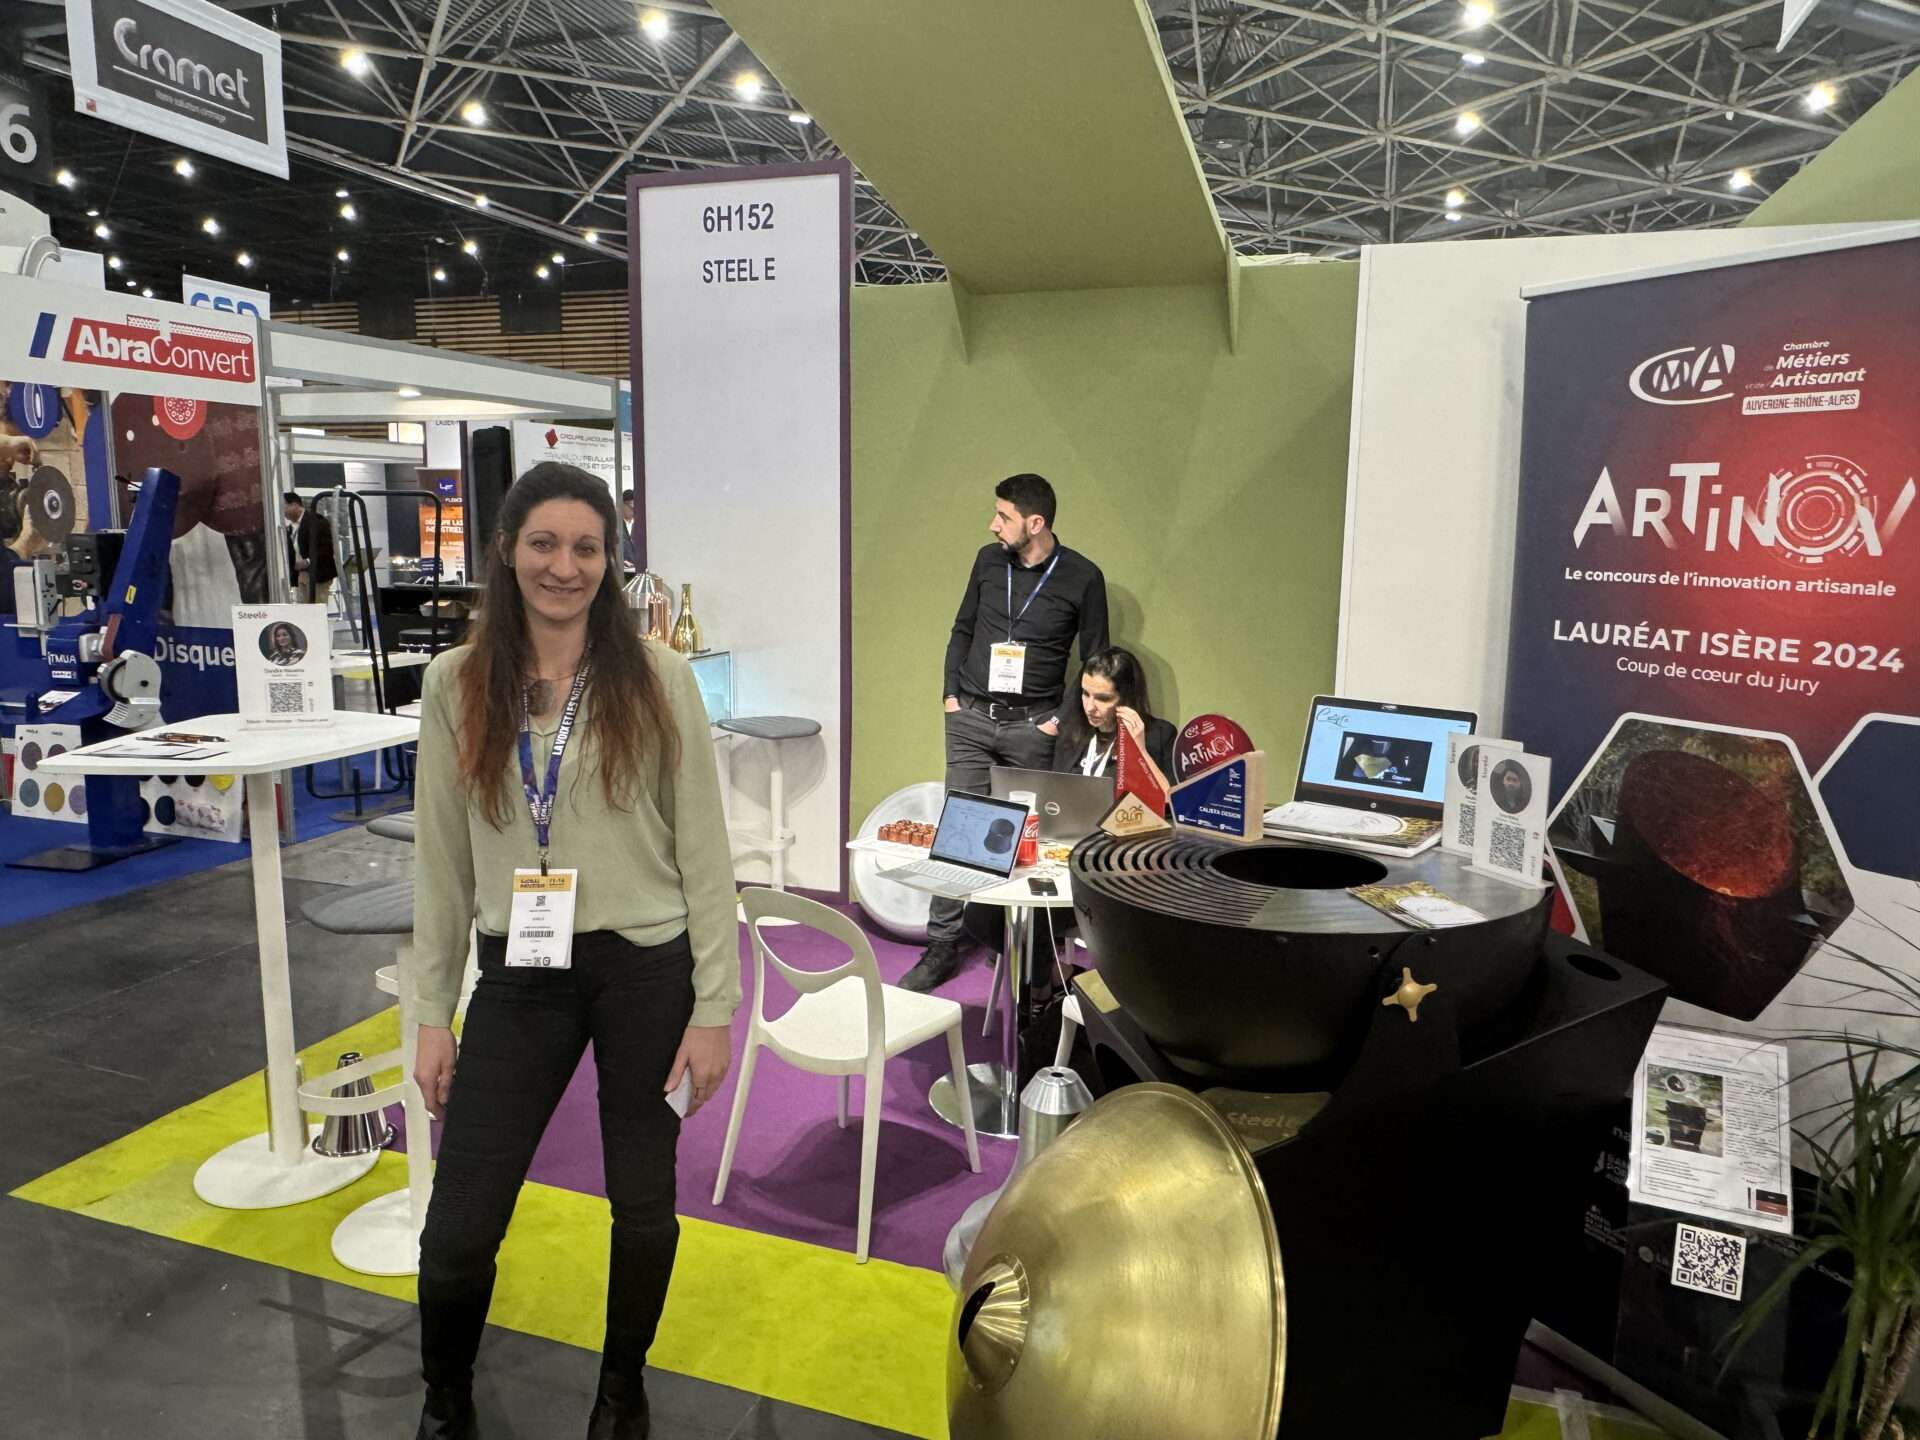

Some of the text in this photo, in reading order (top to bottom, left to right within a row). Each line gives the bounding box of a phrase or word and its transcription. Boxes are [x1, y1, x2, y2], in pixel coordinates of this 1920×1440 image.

[113, 17, 250, 109] Cramet
[0, 103, 37, 163] 6
[703, 203, 774, 233] 6H152
[75, 325, 250, 376] AbraConvert
[1776, 352, 1851, 370] Métiers
[1783, 341, 1830, 351] Chambre
[1745, 393, 1857, 410] AUVERGNE-RHÔNE-ALPES
[1565, 568, 1897, 597] Le concours de l'innovation artisanale
[154, 636, 235, 671] Disque
[1553, 619, 1905, 673] LAURÉAT ISÈRE 2024
[1616, 657, 1820, 696] Coup de cœur du jury
